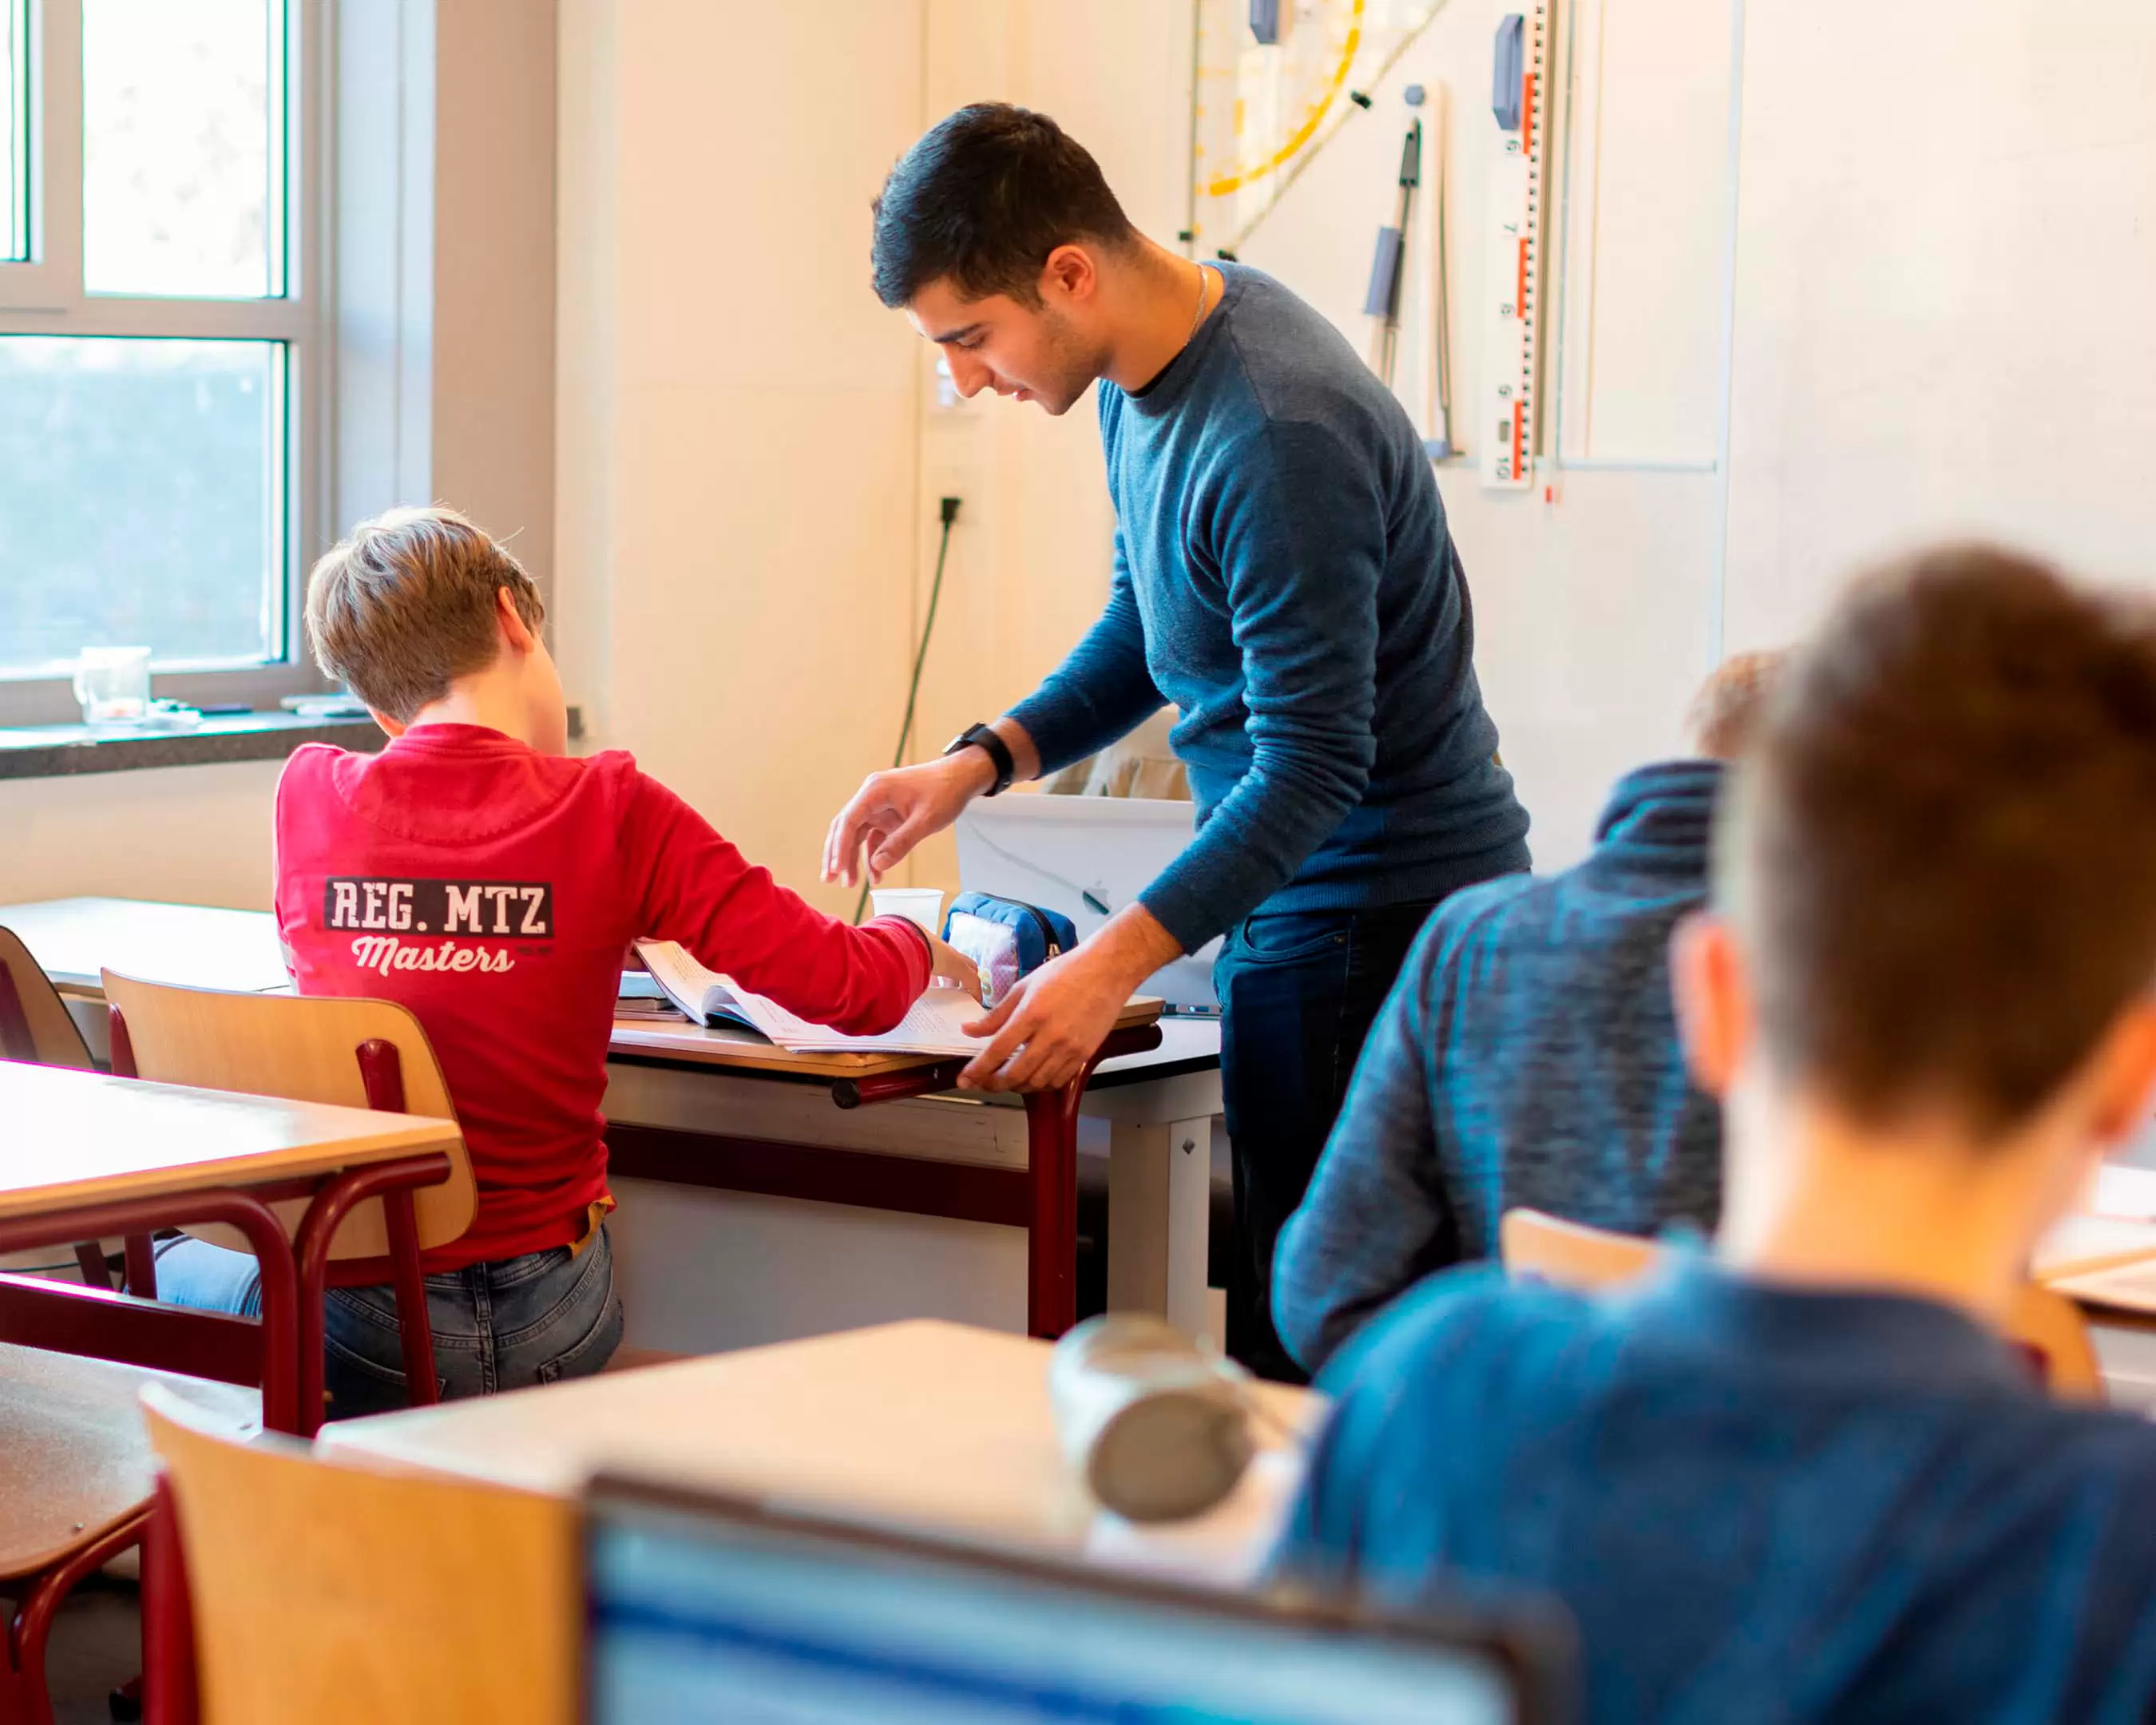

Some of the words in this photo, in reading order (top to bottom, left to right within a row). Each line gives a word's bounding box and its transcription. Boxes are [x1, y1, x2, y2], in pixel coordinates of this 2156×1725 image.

[1507, 140, 1520, 153] 6
[1503, 223, 1517, 232] 7
[1496, 457, 1511, 479] 10
[331, 882, 427, 930] REG.
[444, 885, 546, 934] MTZ
[351, 935, 515, 977] Masters
